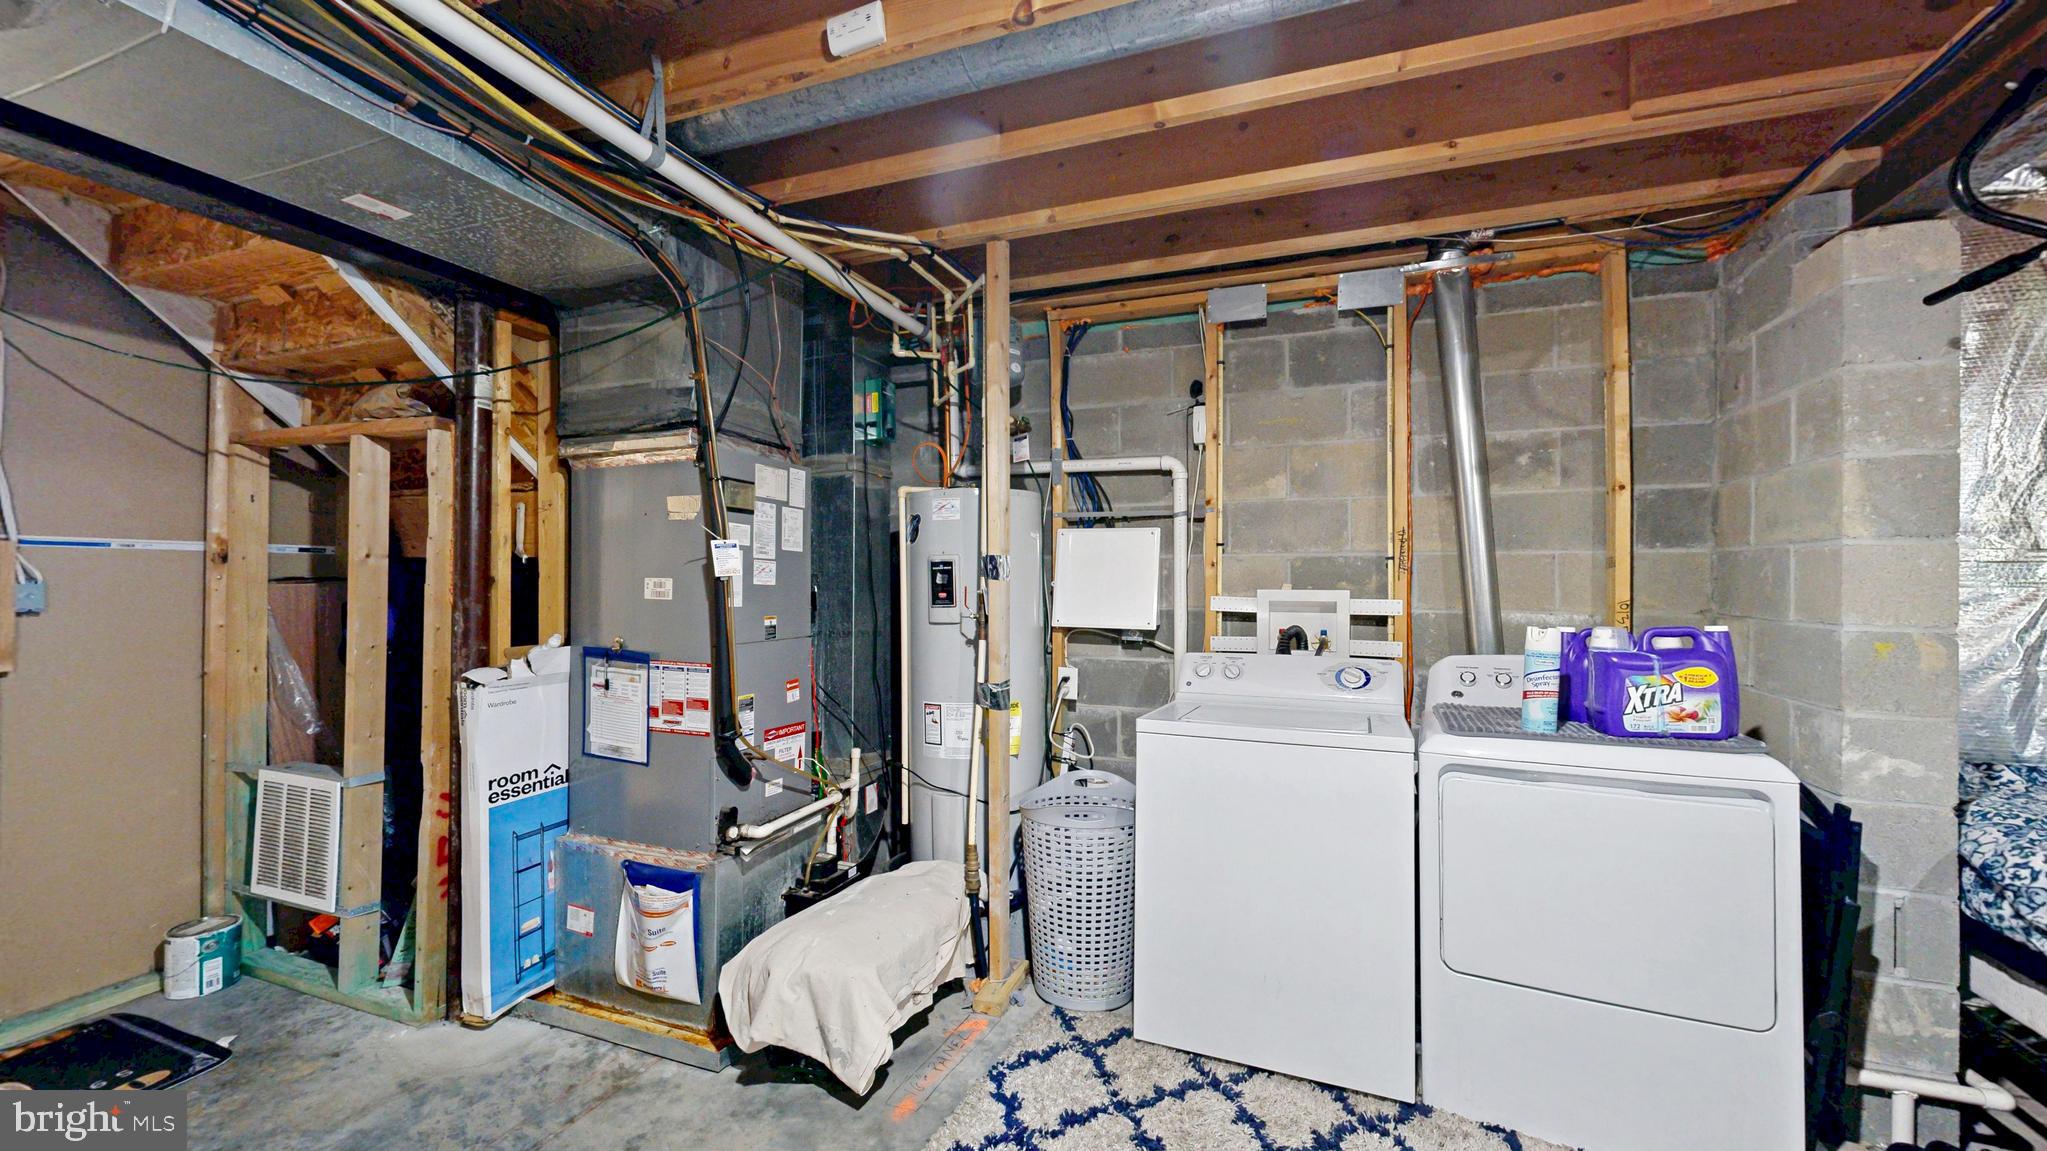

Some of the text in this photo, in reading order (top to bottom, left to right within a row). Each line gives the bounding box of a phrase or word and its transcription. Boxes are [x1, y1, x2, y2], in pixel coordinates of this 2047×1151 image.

[488, 699, 517, 708] Wardrobe
[1623, 681, 1683, 715] XTRA
[776, 723, 806, 736] IMPORTANT
[488, 768, 539, 791] room
[488, 768, 570, 804] essential
